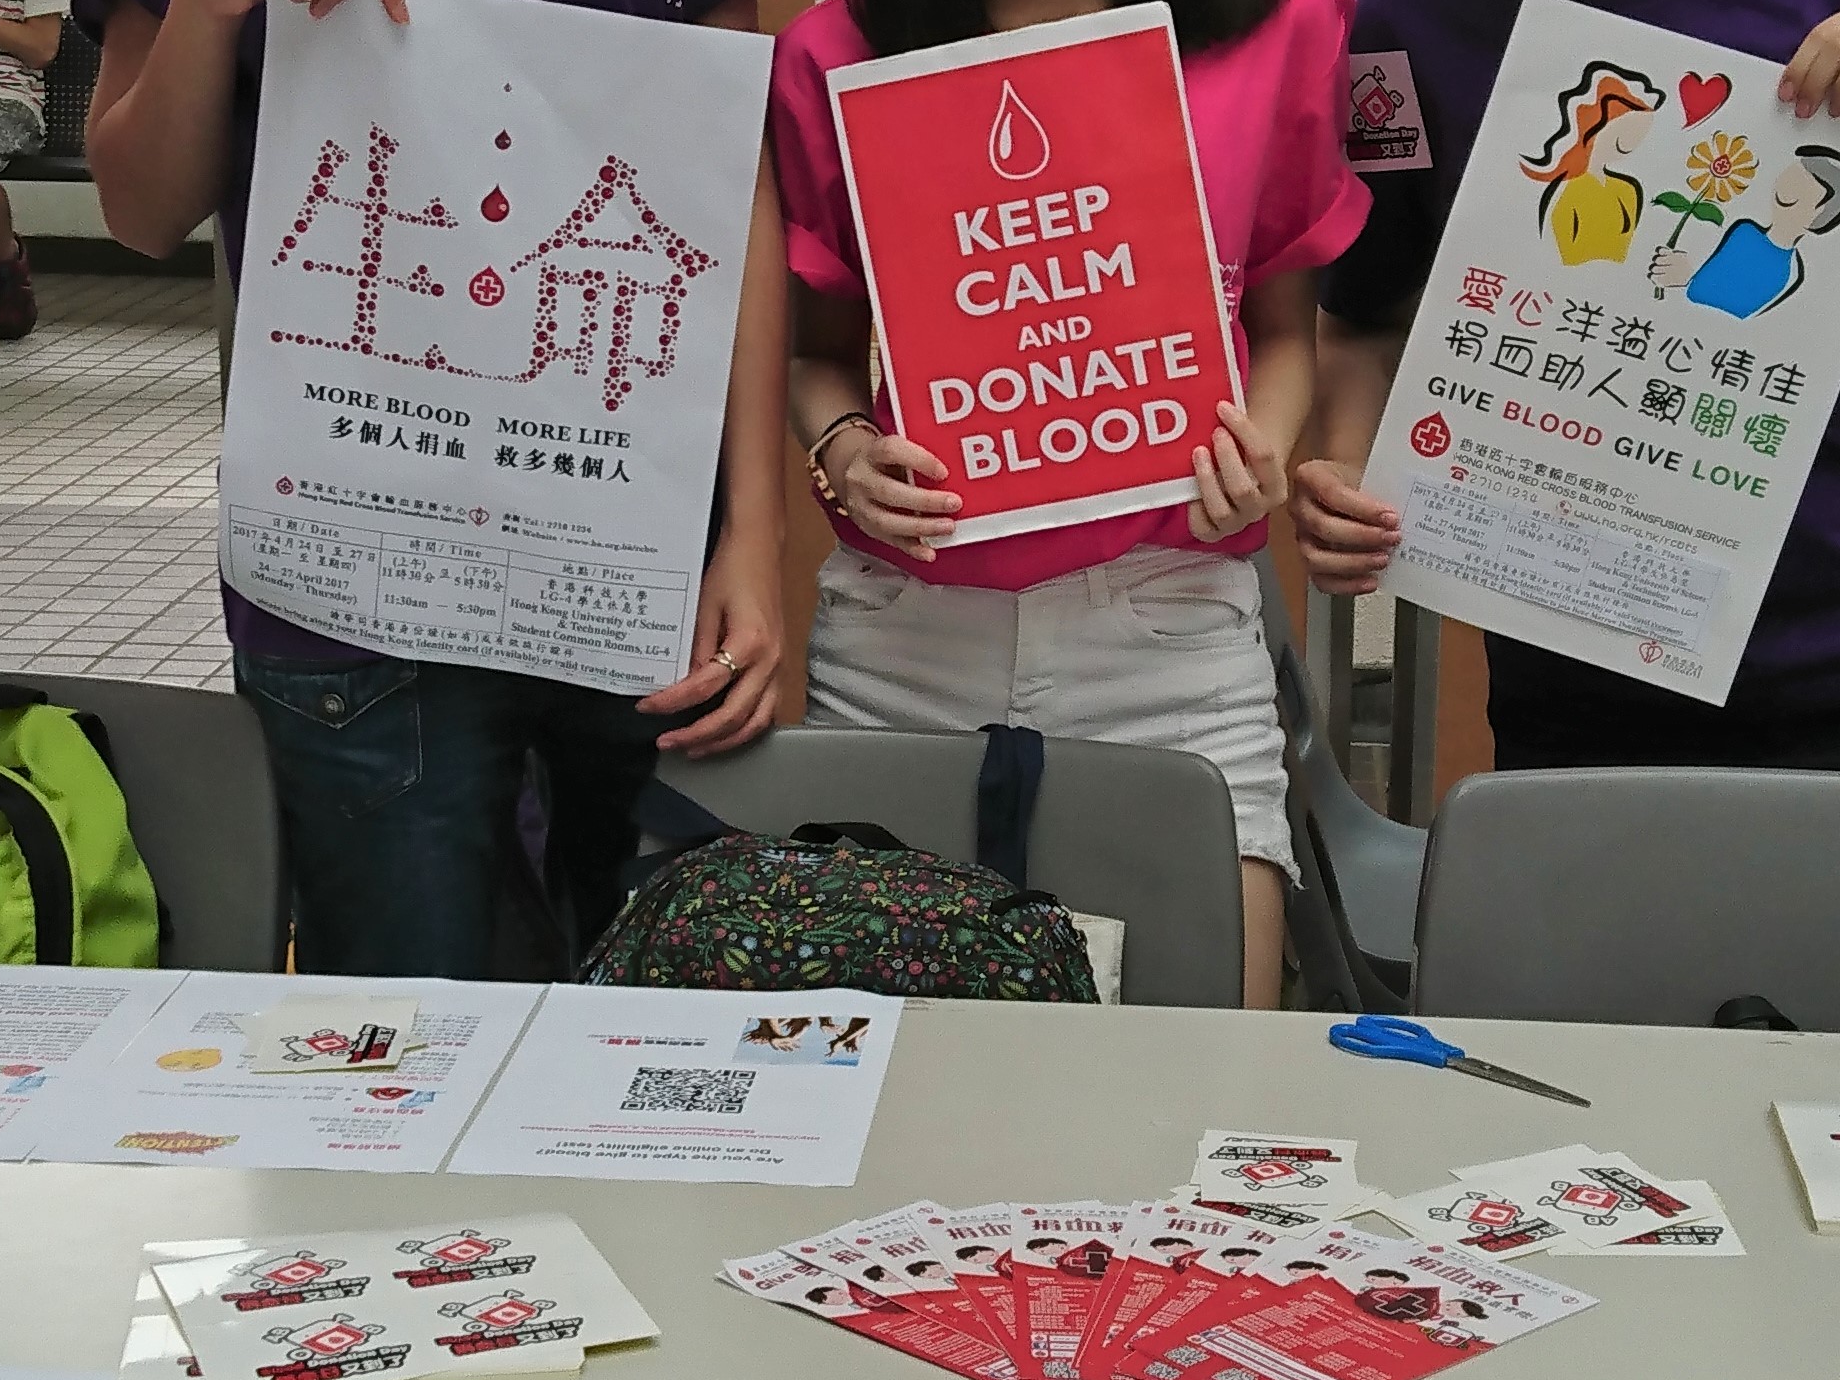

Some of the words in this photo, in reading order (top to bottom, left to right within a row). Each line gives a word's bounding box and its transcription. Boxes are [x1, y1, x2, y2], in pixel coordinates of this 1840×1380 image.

[954, 184, 1111, 256] KEEP
[270, 122, 719, 412] 生命
[955, 243, 1136, 318] CALM
[1017, 316, 1093, 352] AND
[1457, 267, 1807, 407] 愛心洋溢心情佳
[304, 383, 378, 410] MORE
[386, 397, 470, 426] BLOOD
[497, 418, 571, 441] MORE
[578, 428, 630, 448] LIFE
[928, 332, 1200, 425] DONATE
[1445, 320, 1790, 458] 捐血助人顯關懷
[330, 417, 466, 459] 多個人捐血
[495, 445, 630, 482] 救多幾個人
[960, 399, 1189, 480] BLOOD
[1429, 376, 1496, 412] GIVE
[1503, 401, 1604, 446] BLOOD
[1614, 437, 1683, 471] GIVE
[1692, 459, 1770, 498] LOVE
[1452, 451, 1483, 472] HONG
[1485, 461, 1515, 481] KONG
[1517, 471, 1539, 489] RED
[1540, 478, 1577, 500] CROSS
[1579, 490, 1618, 513] BLOOD
[1619, 503, 1695, 536] TRANSFUSION
[1696, 526, 1742, 551] SERVICE
